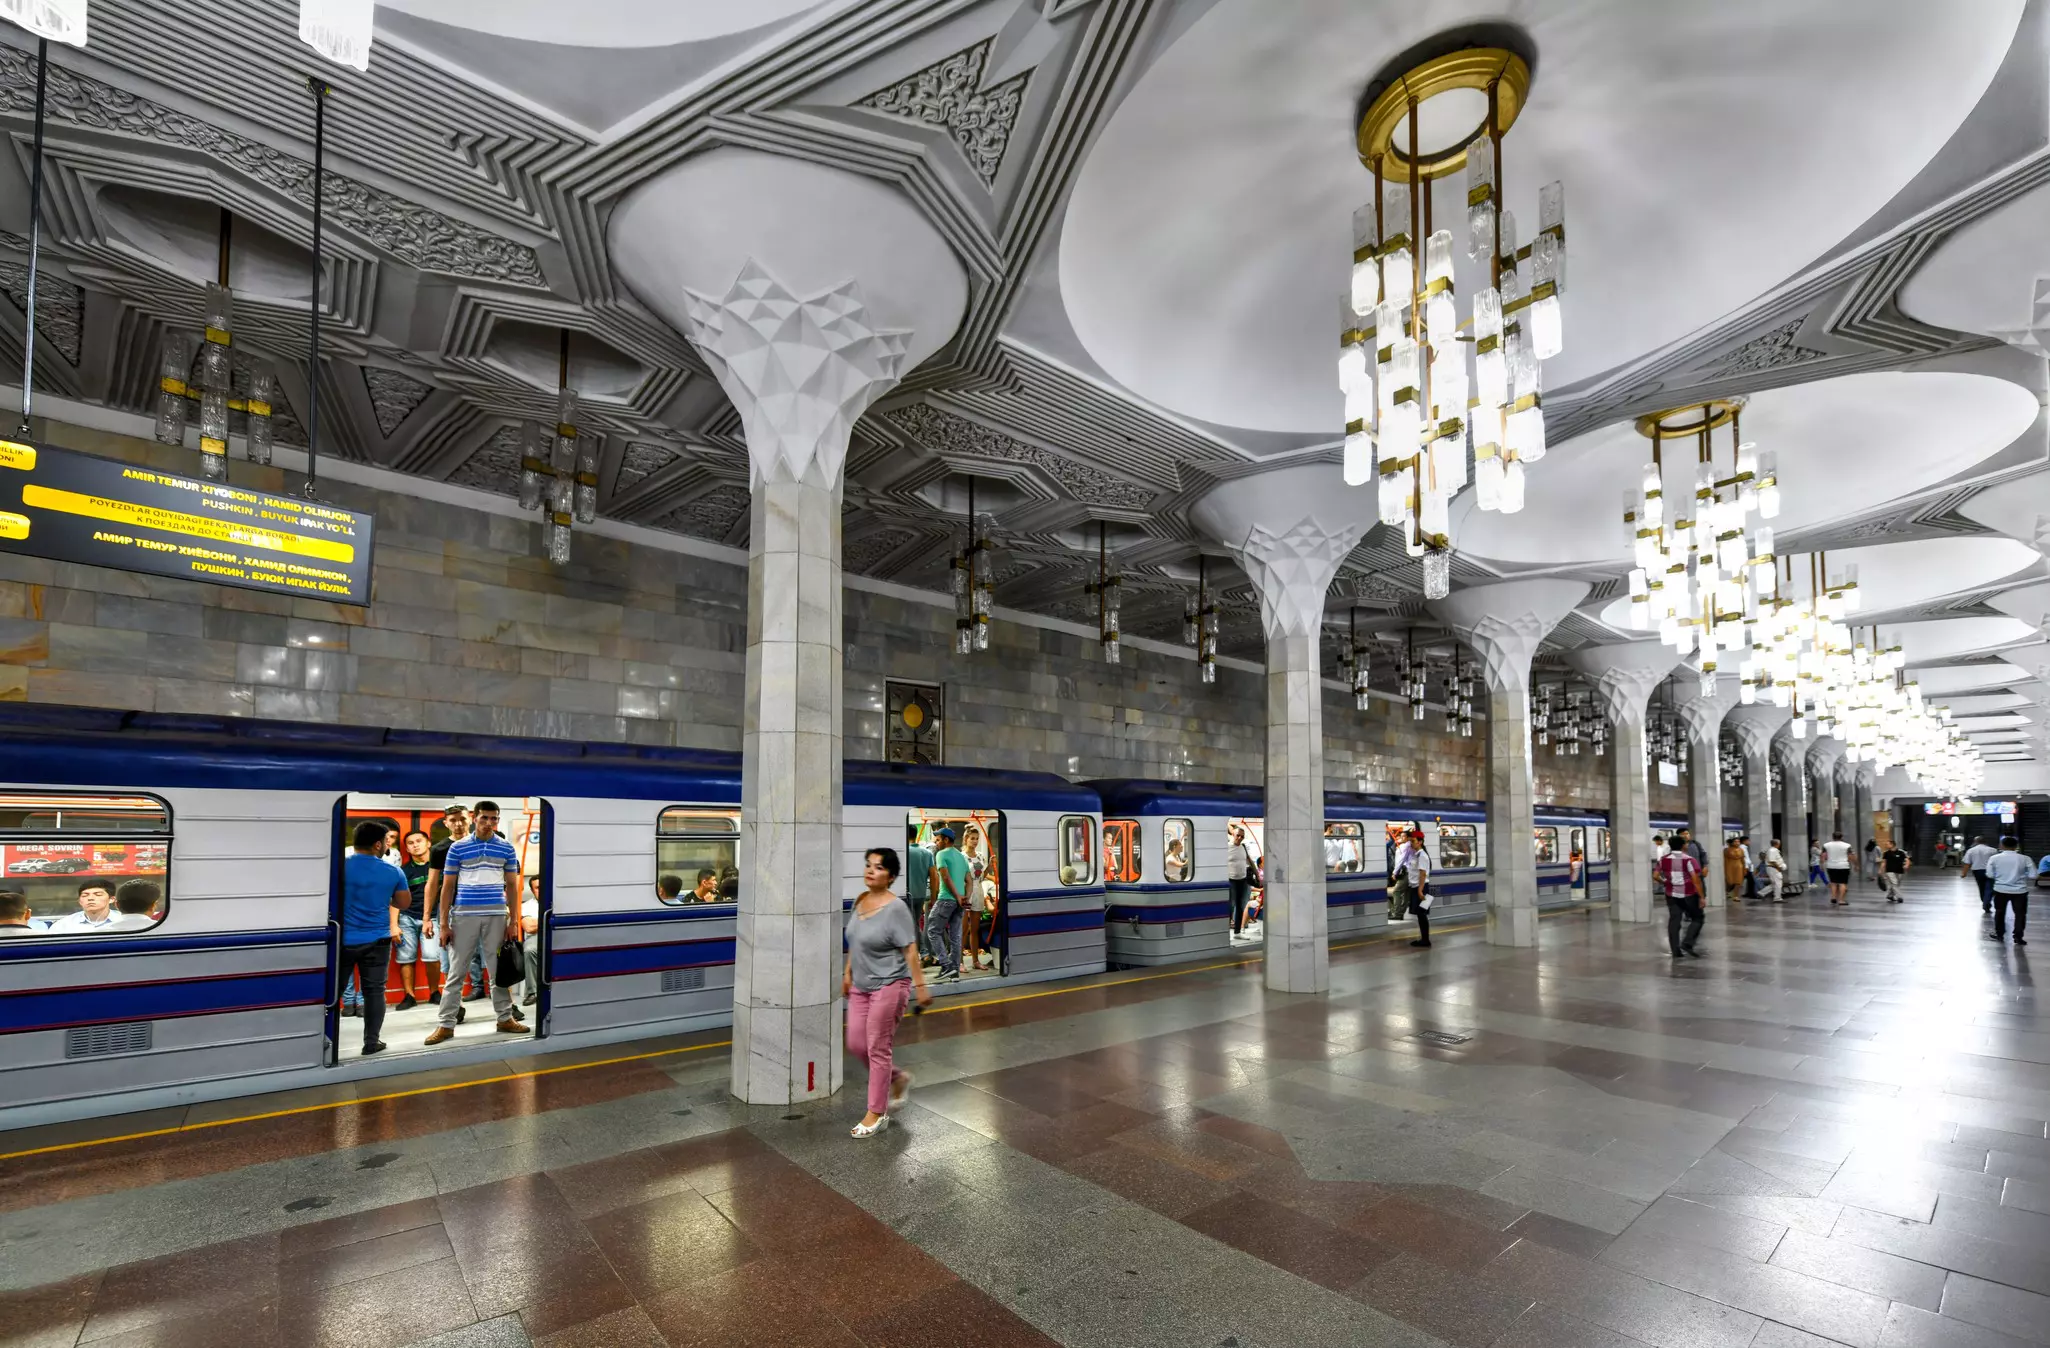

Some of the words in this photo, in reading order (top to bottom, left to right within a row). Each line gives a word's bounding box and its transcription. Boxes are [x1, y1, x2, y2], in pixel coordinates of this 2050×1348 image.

[122, 468, 156, 483] AMIR
[157, 475, 200, 492] TEMUR
[263, 497, 302, 513] HAMID
[89, 498, 151, 515] POYEZDLAR
[152, 510, 202, 524] QUYIDAGI
[203, 519, 264, 536] BEKATLARGA
[145, 517, 195, 532] ПОЕЗДАМ
[197, 527, 212, 535] ДО
[260, 509, 299, 525] BUYUK
[300, 517, 325, 530] IPAK
[93, 531, 133, 545] АМИР
[134, 538, 178, 553] ТЕМУР
[243, 556, 287, 573] ХАМИД
[252, 571, 285, 585] БУЮК
[286, 577, 317, 590] ИПАК
[16, 844, 44, 852] MEGA
[47, 844, 83, 852] SOVRIN
